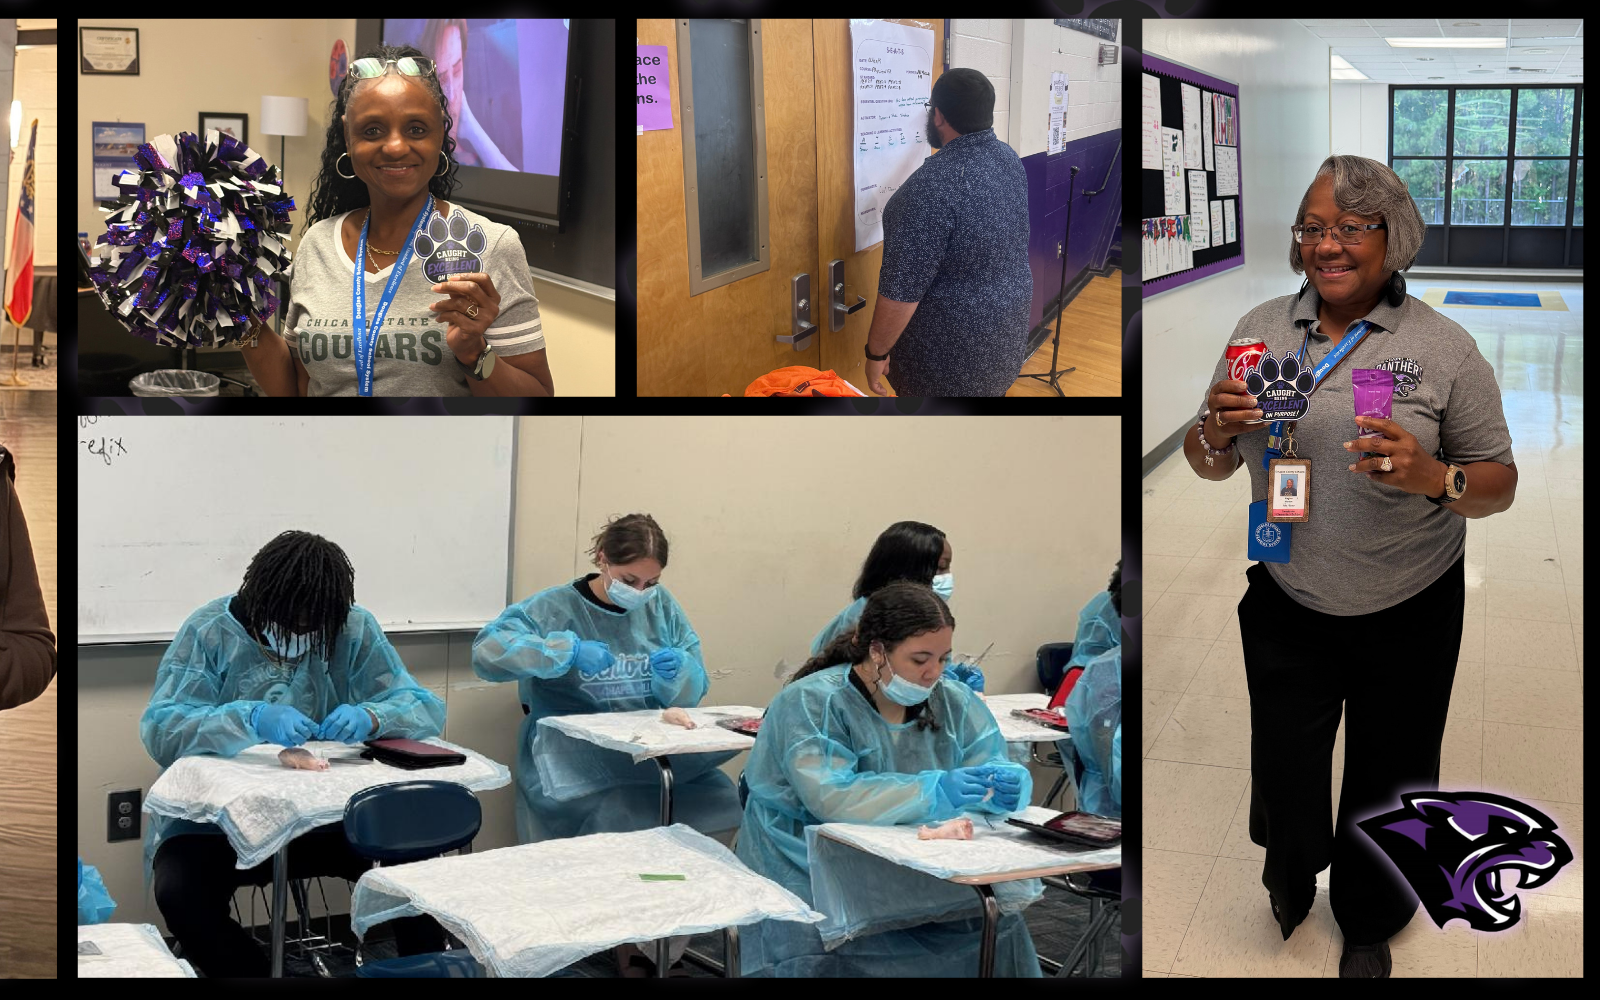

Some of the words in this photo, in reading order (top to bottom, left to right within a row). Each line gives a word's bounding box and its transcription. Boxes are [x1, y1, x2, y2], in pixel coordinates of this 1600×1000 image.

[436, 249, 467, 259] CAUGHT
[427, 258, 479, 276] EXCELLENT
[355, 296, 363, 320] Douglas
[376, 301, 388, 325] Douglas
[306, 318, 370, 329] CHICAO
[369, 325, 379, 347] County
[299, 330, 443, 366] COUARS
[1266, 389, 1297, 398] CAUGHT
[1257, 398, 1306, 410] EXCELLENT
[1273, 410, 1299, 418] PURPOSE!
